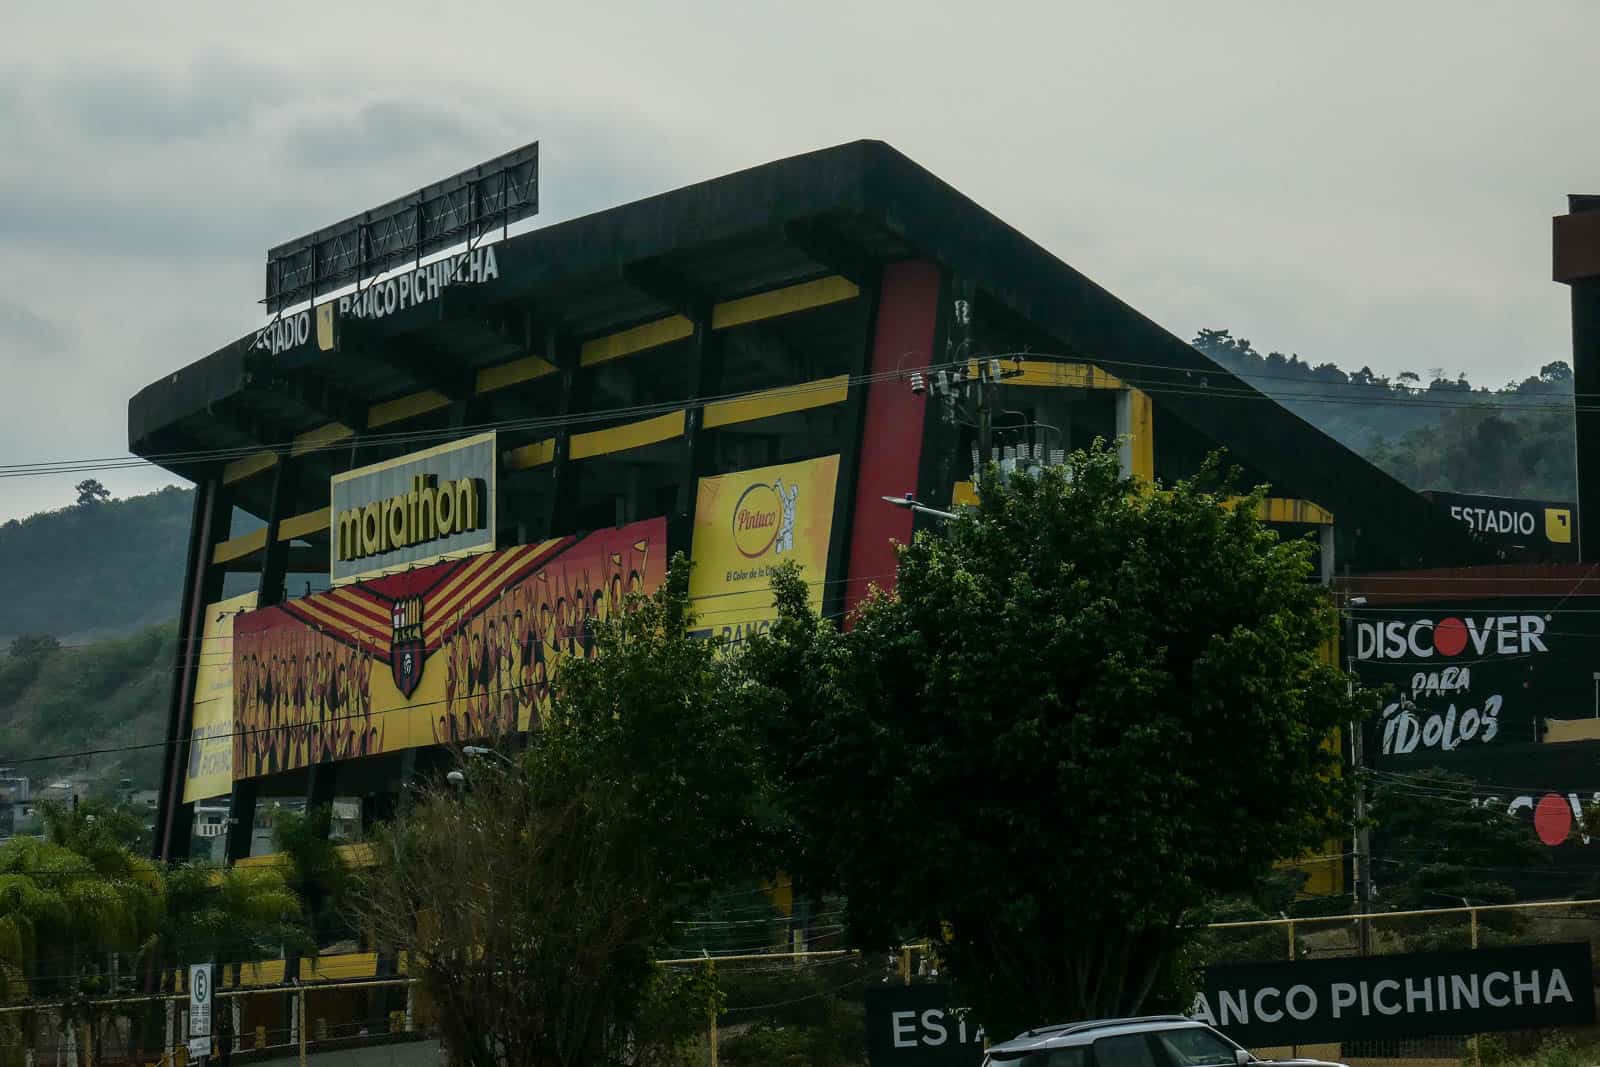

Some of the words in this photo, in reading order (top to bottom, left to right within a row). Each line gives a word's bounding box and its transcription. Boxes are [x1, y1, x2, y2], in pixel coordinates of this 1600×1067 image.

[399, 246, 499, 310] PICHINCHA
[338, 473, 478, 560] marathon
[739, 509, 776, 531] Pintuco
[1450, 505, 1535, 536] ESTADIO
[733, 568, 748, 581] Color
[1357, 615, 1549, 659] DISCOVER
[1411, 667, 1471, 700] PARA
[1190, 984, 1318, 1026] ANCO
[1330, 968, 1573, 1019] PICHINCHA
